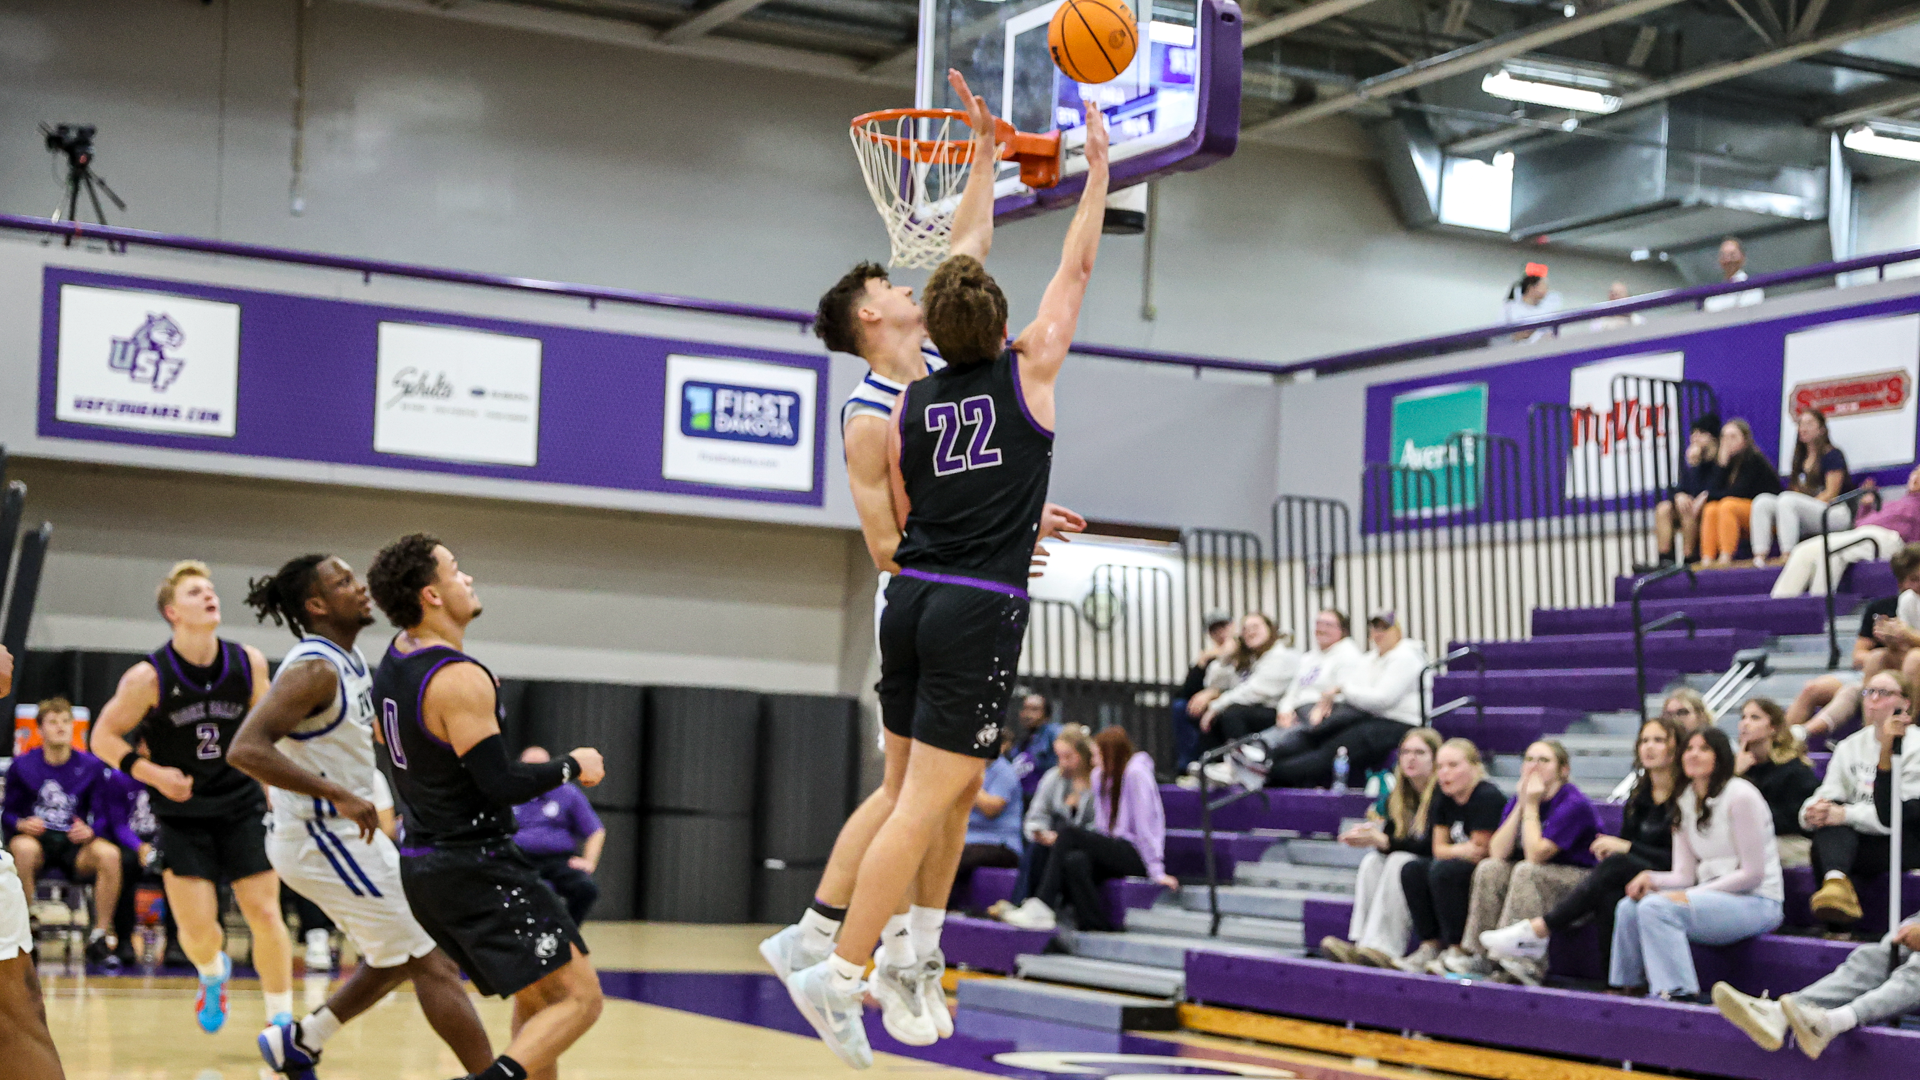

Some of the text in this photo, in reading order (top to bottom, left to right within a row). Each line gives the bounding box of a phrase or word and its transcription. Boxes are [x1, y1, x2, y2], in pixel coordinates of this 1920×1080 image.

[109, 335, 186, 392] USF
[714, 412, 795, 440] DAKOTA
[715, 388, 796, 420] FIRST
[924, 394, 1003, 477] 22
[195, 722, 222, 760] 2
[382, 697, 408, 770] 0
